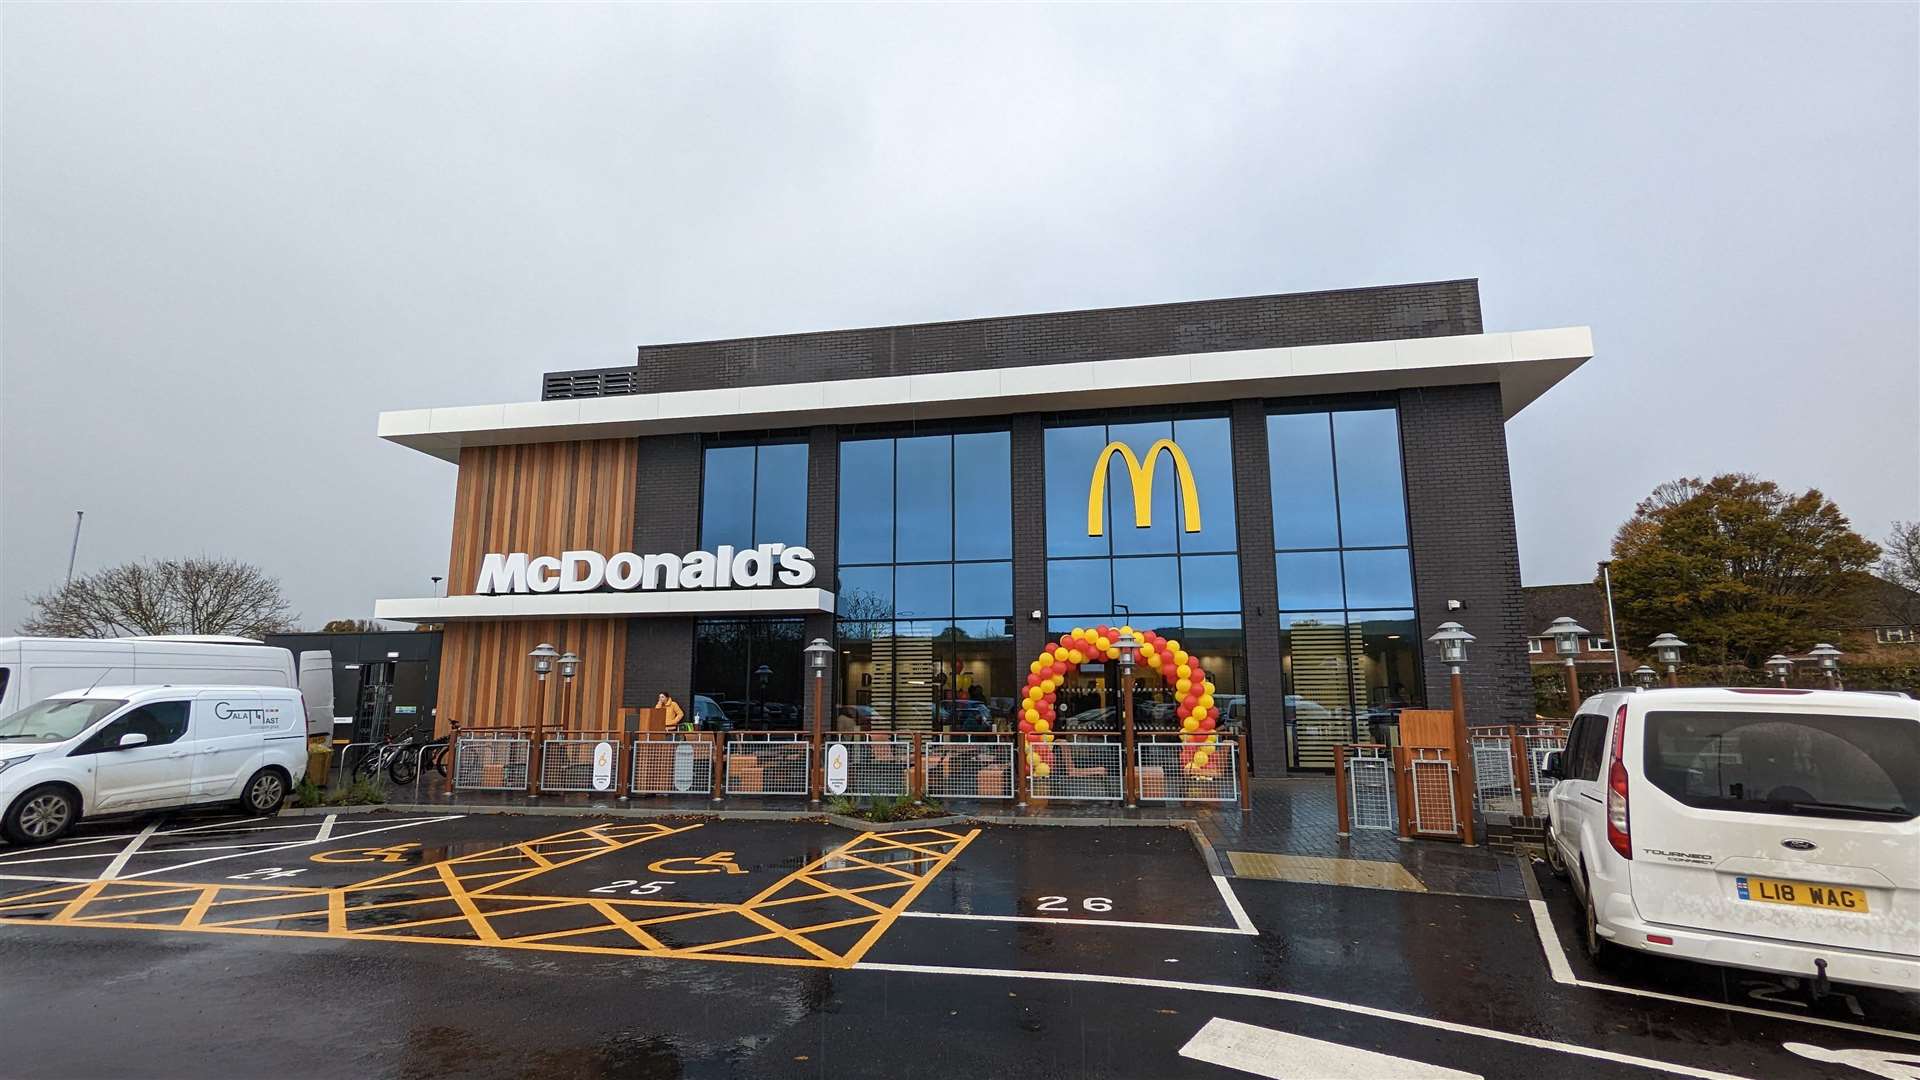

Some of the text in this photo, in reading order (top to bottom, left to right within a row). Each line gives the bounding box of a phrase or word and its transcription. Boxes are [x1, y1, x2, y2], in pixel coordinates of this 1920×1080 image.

[475, 542, 816, 595] McDonald's
[1643, 848, 1713, 860] TOURNEO
[226, 867, 309, 880] 24
[588, 880, 676, 894] 25
[1036, 895, 1113, 912] 26
[1809, 887, 1855, 908] WAG
